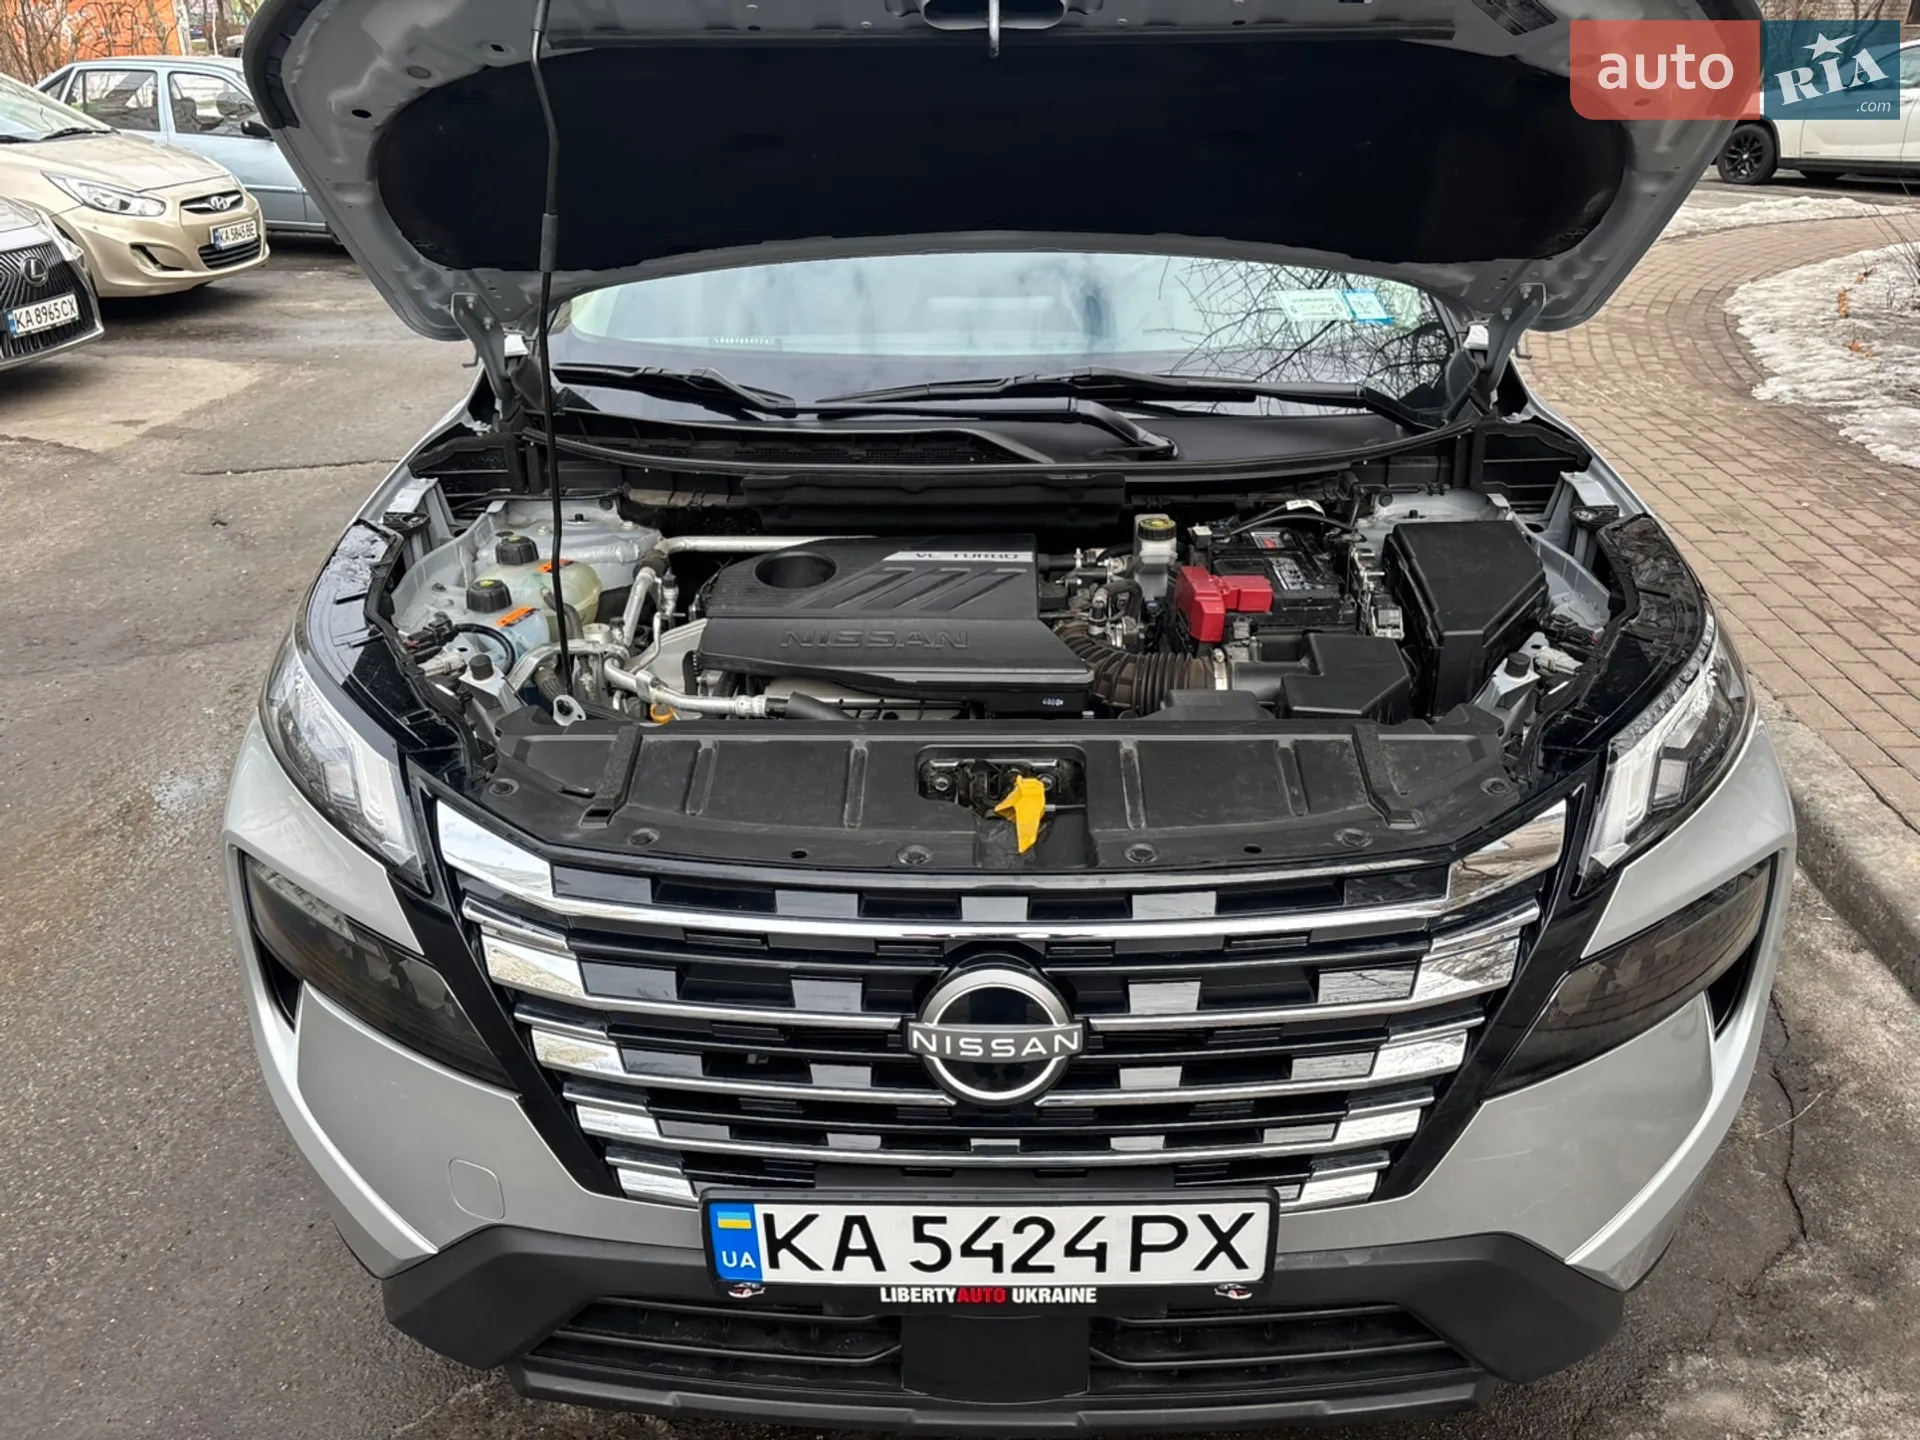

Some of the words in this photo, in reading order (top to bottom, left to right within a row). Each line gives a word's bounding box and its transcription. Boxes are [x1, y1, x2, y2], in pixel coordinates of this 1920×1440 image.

[230, 226, 246, 241] 5845
[245, 223, 255, 238] BE
[14, 310, 34, 331] KA
[34, 303, 61, 325] 8965
[61, 297, 77, 317] CX
[780, 629, 969, 649] NISSAN
[911, 1030, 1079, 1058] NISSAN
[763, 1213, 886, 1272] KA
[909, 1214, 1108, 1273] 5424
[1129, 1212, 1256, 1273] PX
[721, 1251, 756, 1268] UA
[1012, 1287, 1097, 1303] UKRAINE
